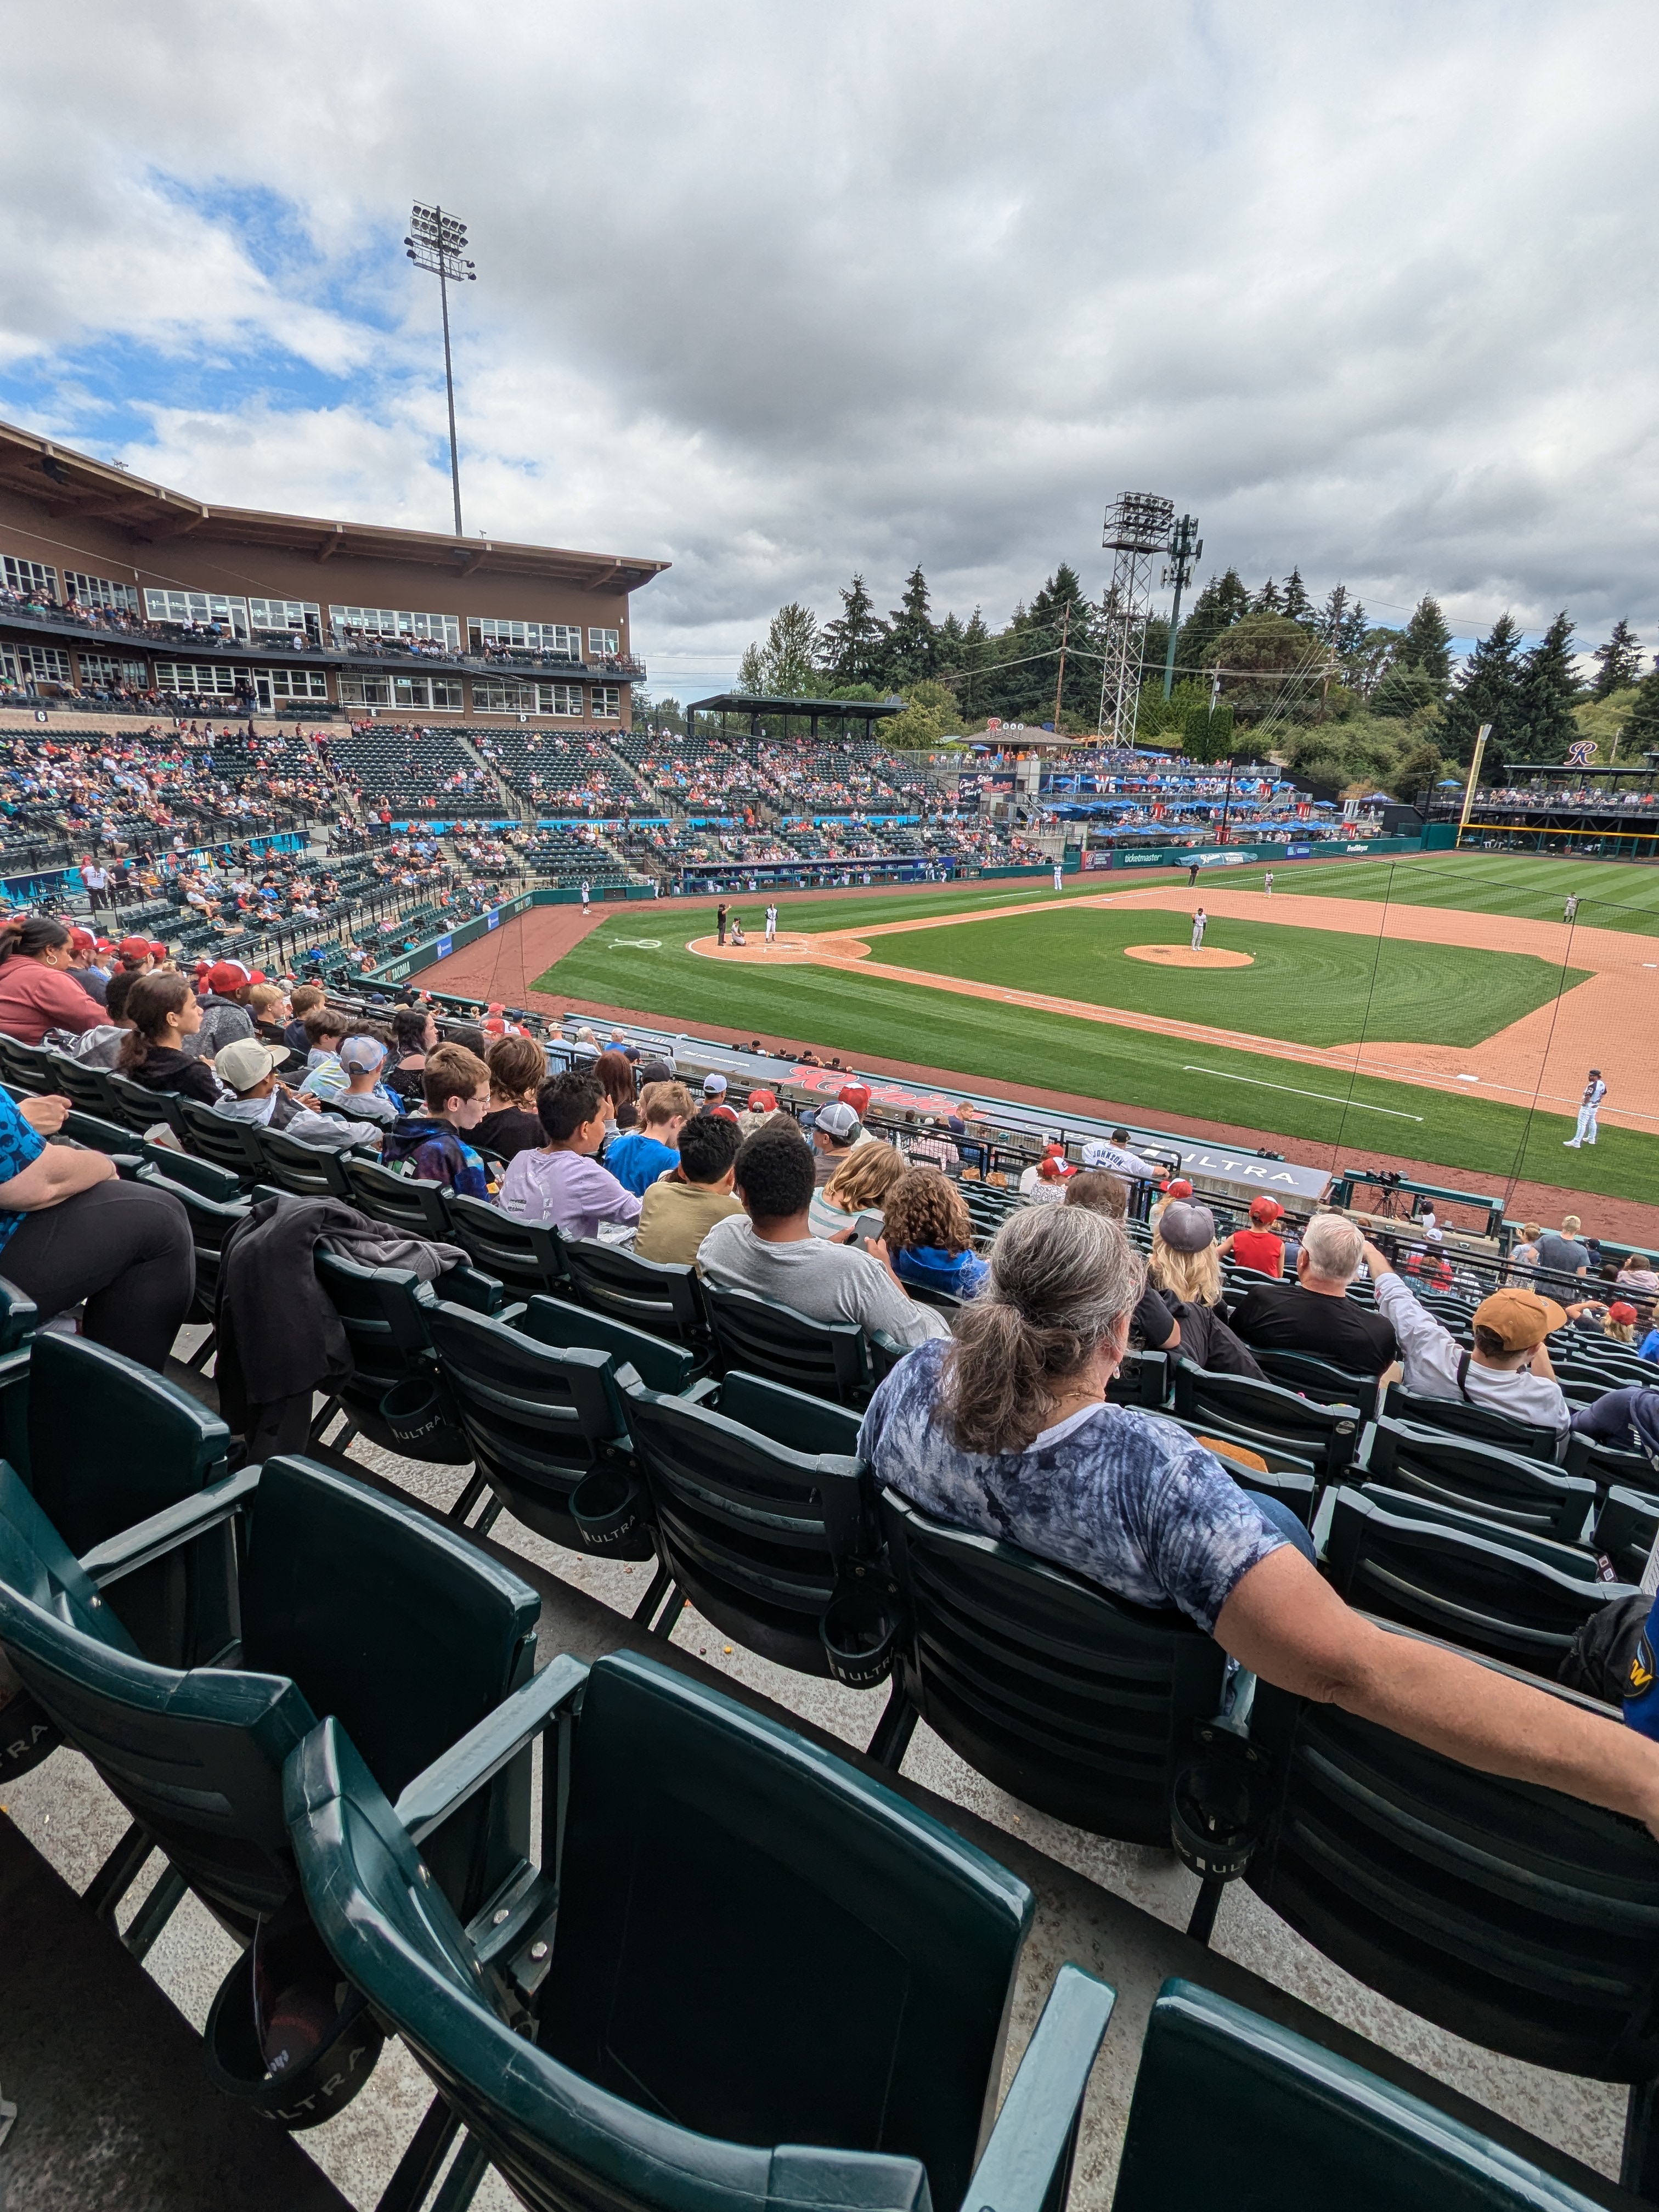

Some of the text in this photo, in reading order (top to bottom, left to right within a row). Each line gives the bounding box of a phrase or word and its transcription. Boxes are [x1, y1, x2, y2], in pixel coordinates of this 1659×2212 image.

[38, 711, 46, 721] G
[175, 718, 179, 726] F
[1003, 722, 1024, 730] BAR
[1564, 741, 1598, 766] R
[1094, 775, 1117, 793] WE
[1125, 854, 1159, 862] ticketmaster
[392, 961, 410, 981] TACOMA
[760, 1065, 995, 1120] Rinie
[1093, 1149, 1124, 1167] JOHNSON
[1171, 1153, 1296, 1185] ULTRA
[399, 1415, 441, 1439] ULTRA
[591, 1515, 635, 1543] ULTRA
[0, 1725, 48, 1767] RA
